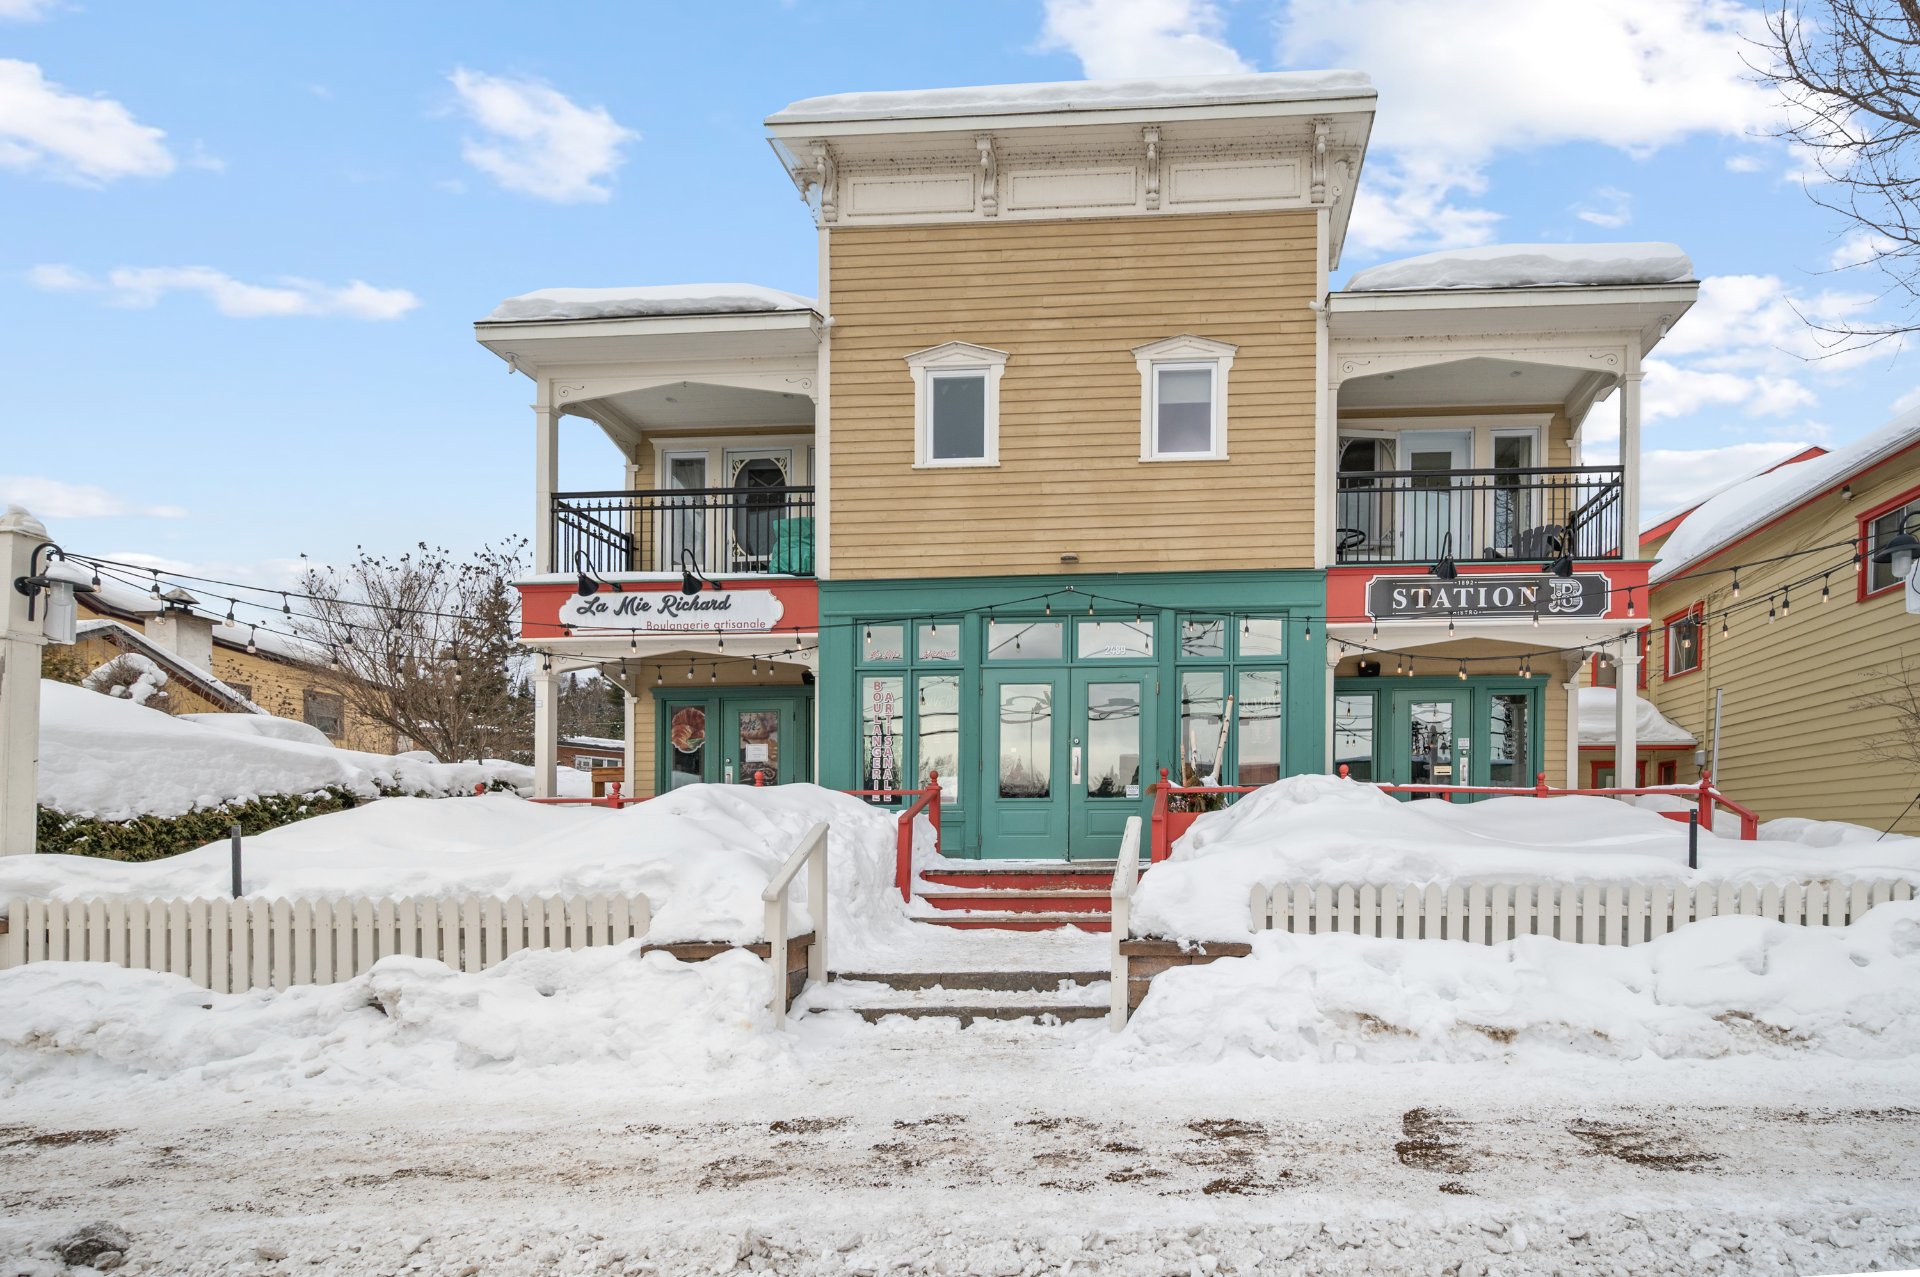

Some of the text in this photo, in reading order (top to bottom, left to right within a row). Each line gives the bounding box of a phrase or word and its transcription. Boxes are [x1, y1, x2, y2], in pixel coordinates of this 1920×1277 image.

[576, 594, 731, 617] La Mie Richard
[1392, 586, 1539, 609] STATION
[646, 618, 766, 632] Boulangerie artisanale
[1104, 645, 1127, 656] 2489
[872, 681, 881, 802] BOULANGERIE
[882, 692, 893, 802] ARTISANALE
